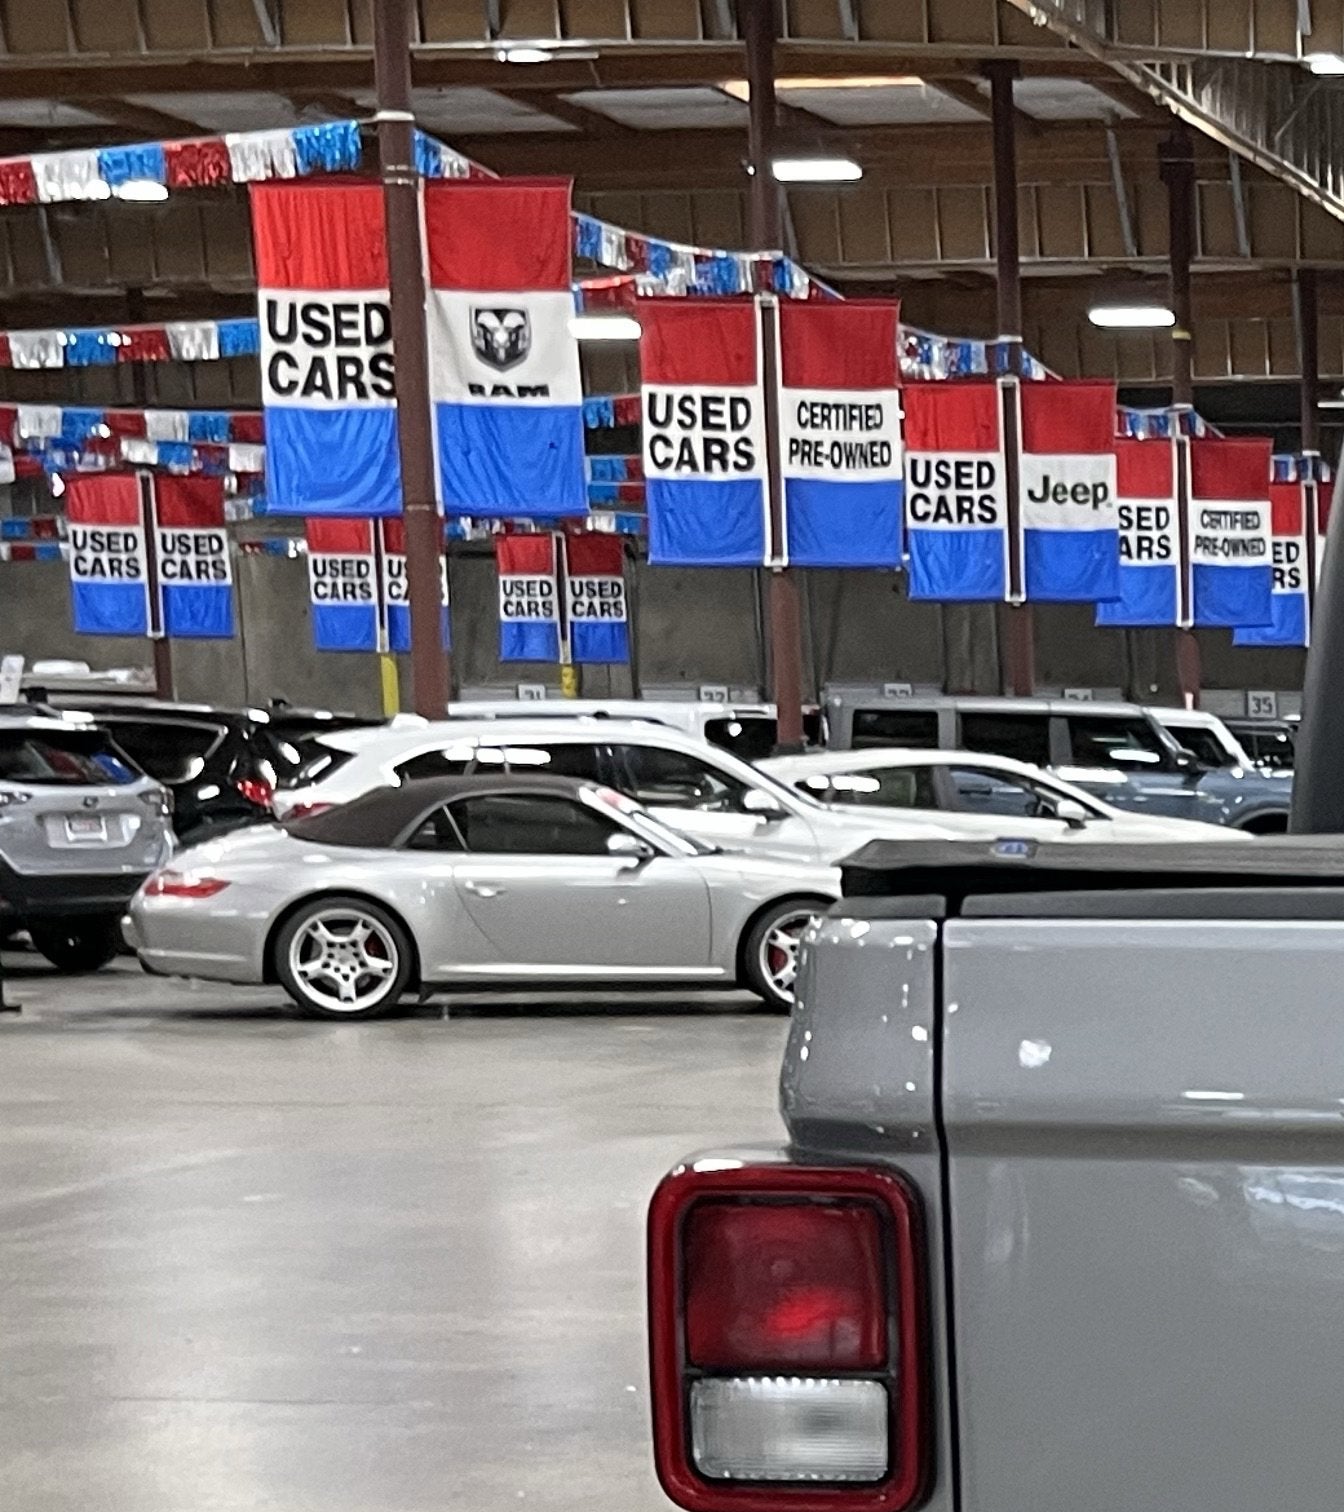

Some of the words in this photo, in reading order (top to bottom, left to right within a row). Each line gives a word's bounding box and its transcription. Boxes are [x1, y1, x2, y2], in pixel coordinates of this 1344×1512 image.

[267, 299, 393, 348] USED
[268, 352, 396, 400] CARS
[468, 383, 550, 398] RAM
[648, 393, 751, 431] USED
[797, 400, 884, 431] CERTIFIED
[649, 434, 756, 472] CARS
[789, 438, 892, 469] PRE-OWNED
[910, 459, 996, 490] USED
[1028, 475, 1109, 510] Jeep
[910, 493, 998, 524] CARS
[1118, 505, 1170, 531] SED
[1200, 509, 1261, 531] CERTIFIED
[72, 529, 138, 554] USED
[160, 532, 224, 556] USED
[1119, 535, 1171, 560] ARS
[1194, 535, 1266, 558] PRE-OWNED
[74, 555, 141, 578] CARS
[161, 558, 227, 580] CARS
[312, 558, 370, 578] USED
[313, 581, 372, 600] CARS
[503, 580, 553, 597] USED
[571, 580, 622, 598] USED
[503, 600, 553, 617] CARS
[571, 600, 623, 617] CARS
[1252, 696, 1272, 714] 35
